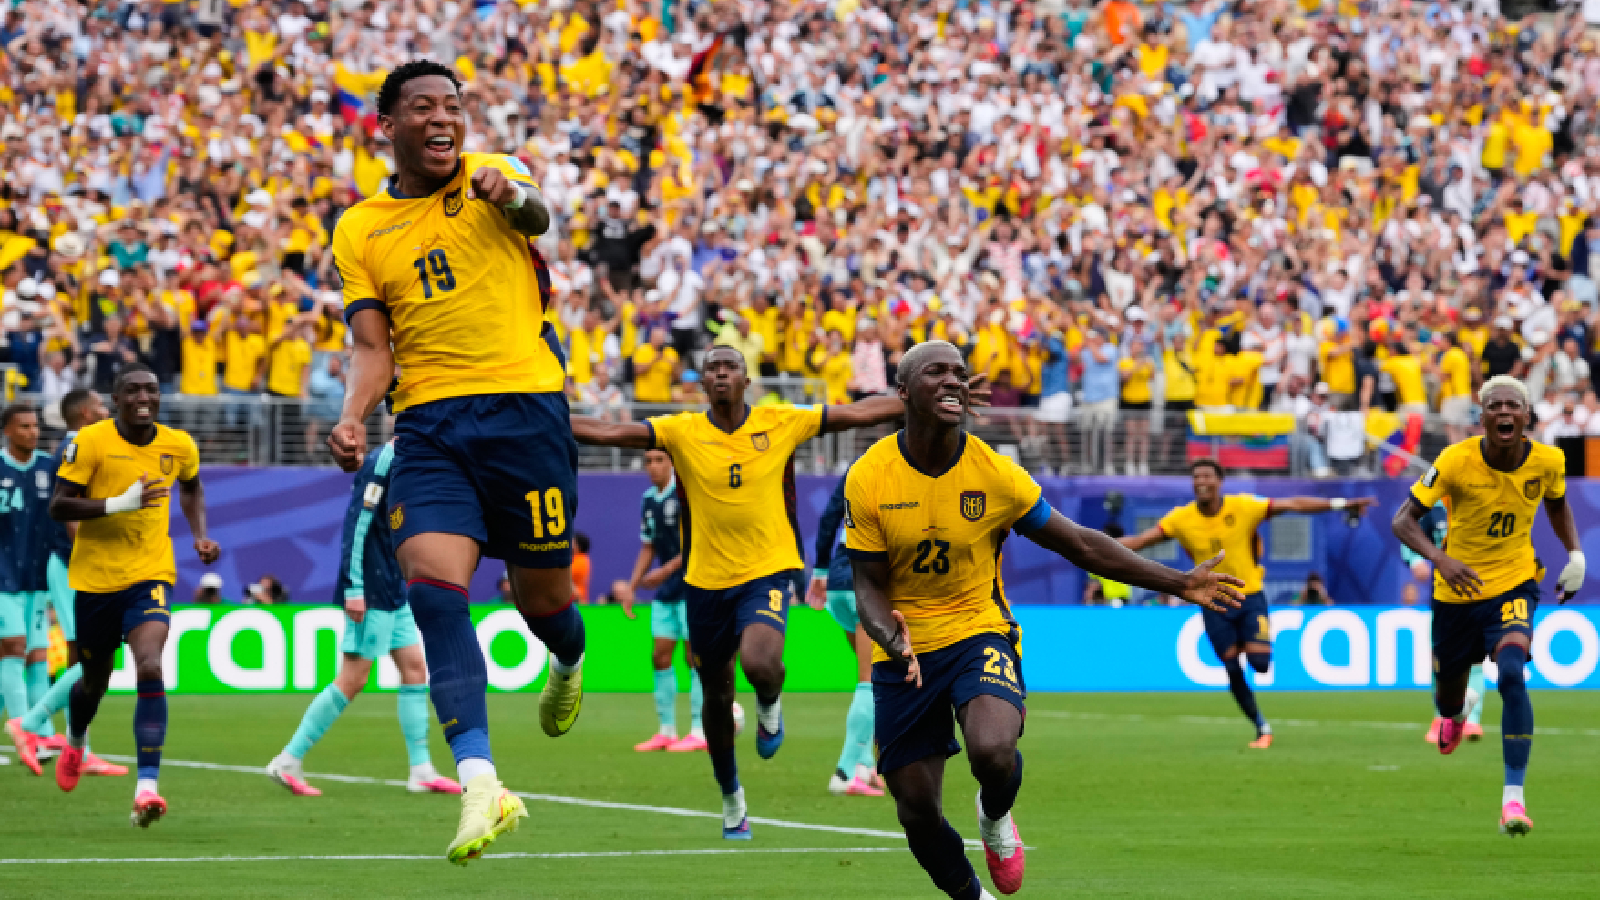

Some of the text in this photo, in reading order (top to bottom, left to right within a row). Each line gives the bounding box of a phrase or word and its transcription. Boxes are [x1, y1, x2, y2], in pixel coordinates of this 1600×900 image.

[414, 249, 456, 299] 19
[729, 463, 742, 489] 6
[525, 487, 567, 538] 19
[1487, 511, 1516, 537] 20
[913, 539, 949, 574] 23
[150, 584, 166, 607] 4
[1501, 597, 1528, 621] 20
[983, 646, 1017, 683] 23
[1176, 609, 1598, 686] aramo
